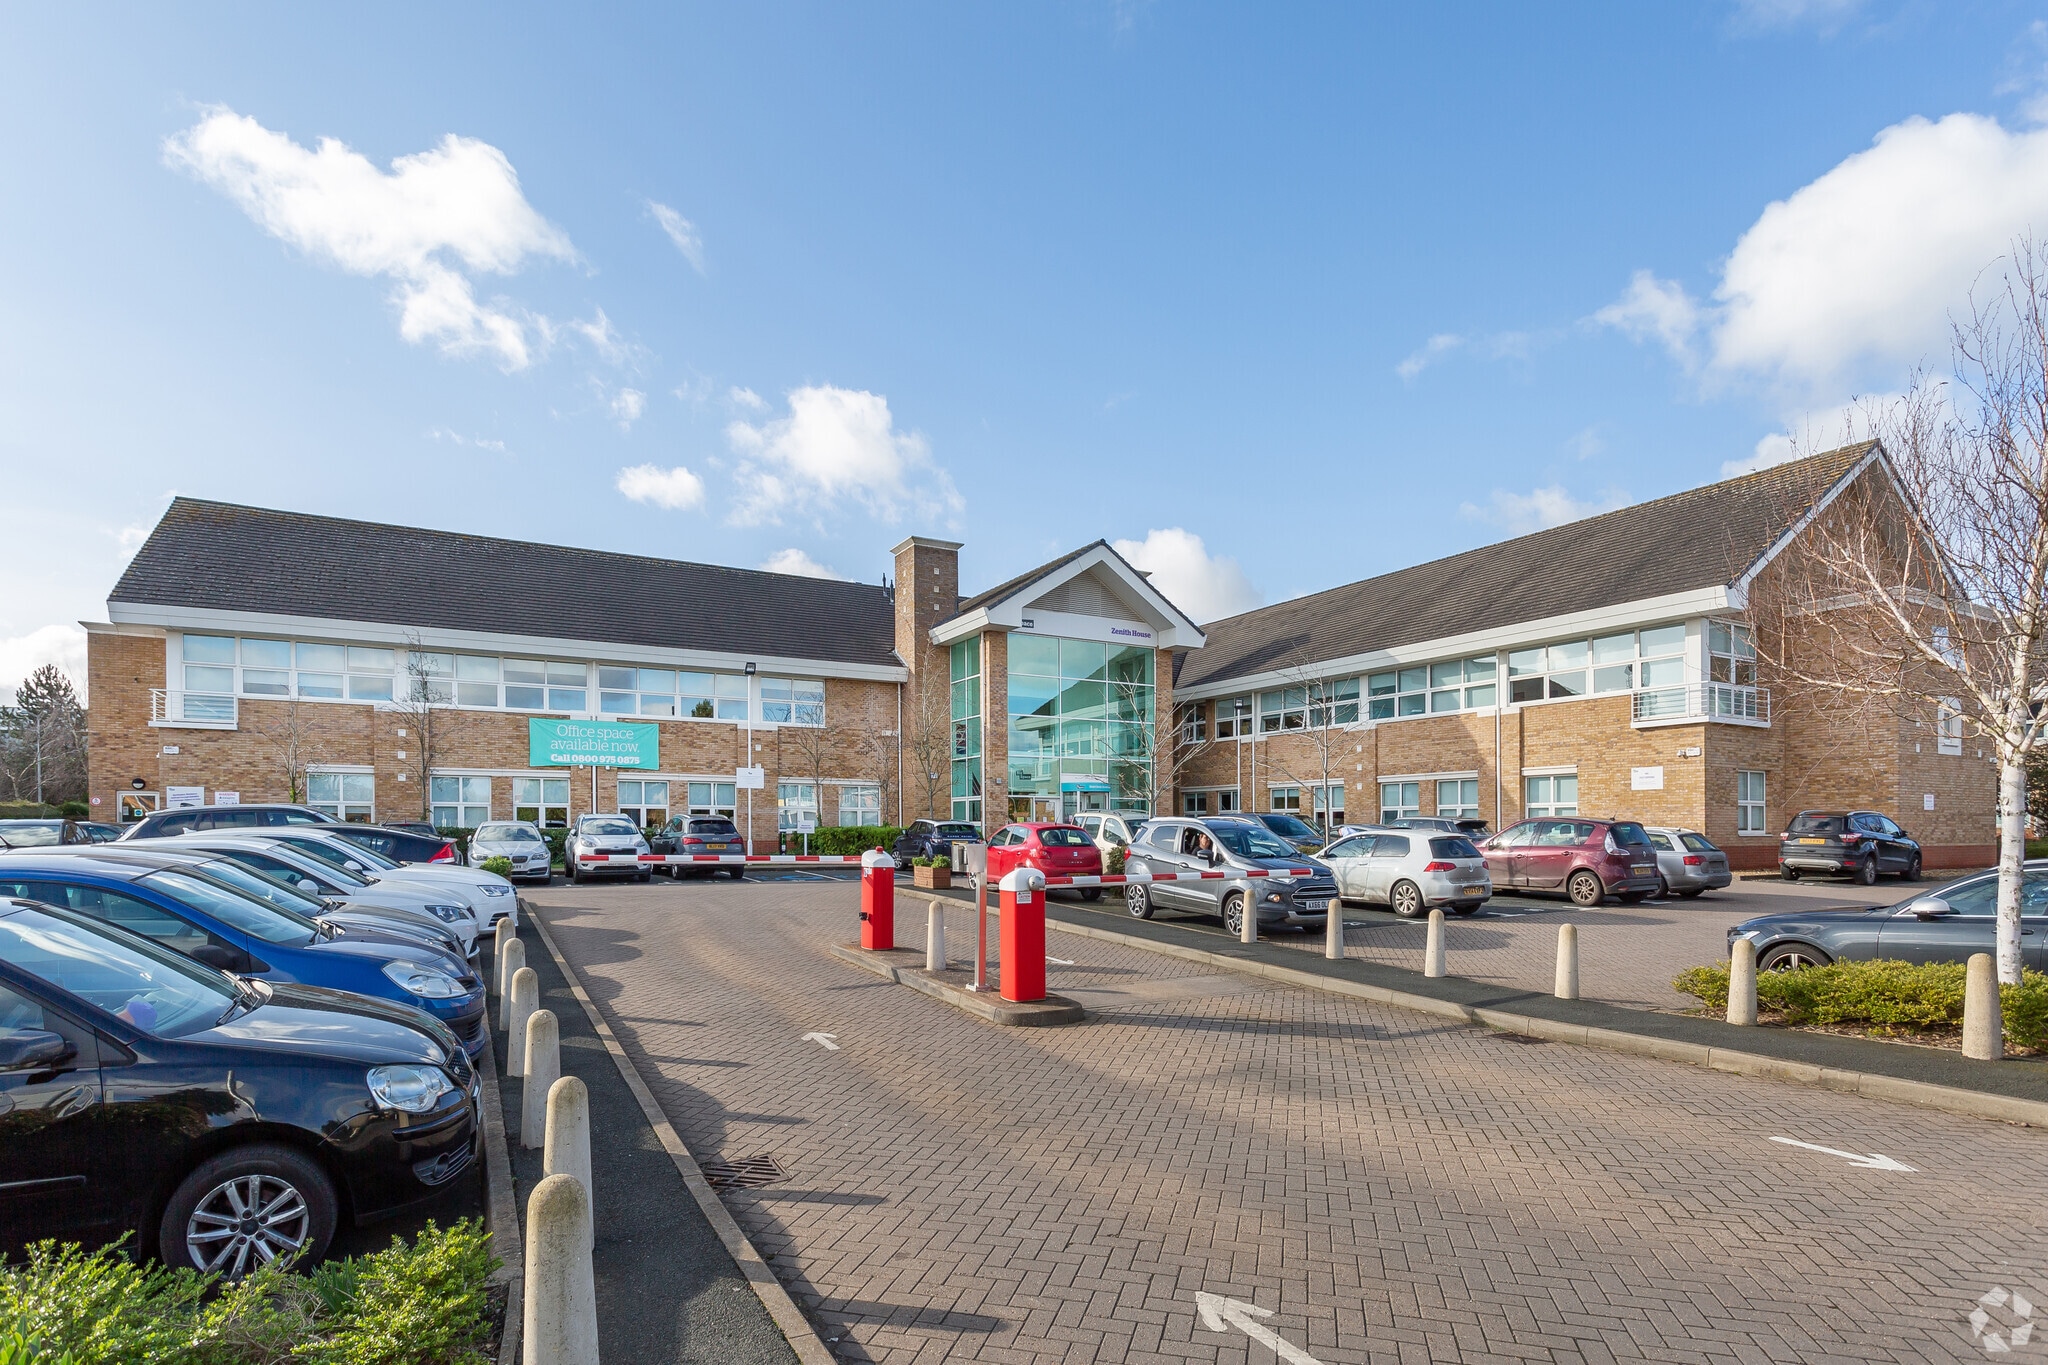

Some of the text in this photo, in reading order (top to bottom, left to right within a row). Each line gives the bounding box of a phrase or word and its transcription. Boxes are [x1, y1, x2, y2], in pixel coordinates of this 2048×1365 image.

[1111, 627, 1151, 639] Zenith House
[556, 724, 634, 741] Office space
[550, 738, 640, 753] available now.
[550, 753, 640, 765] Call 0800 975 0875
